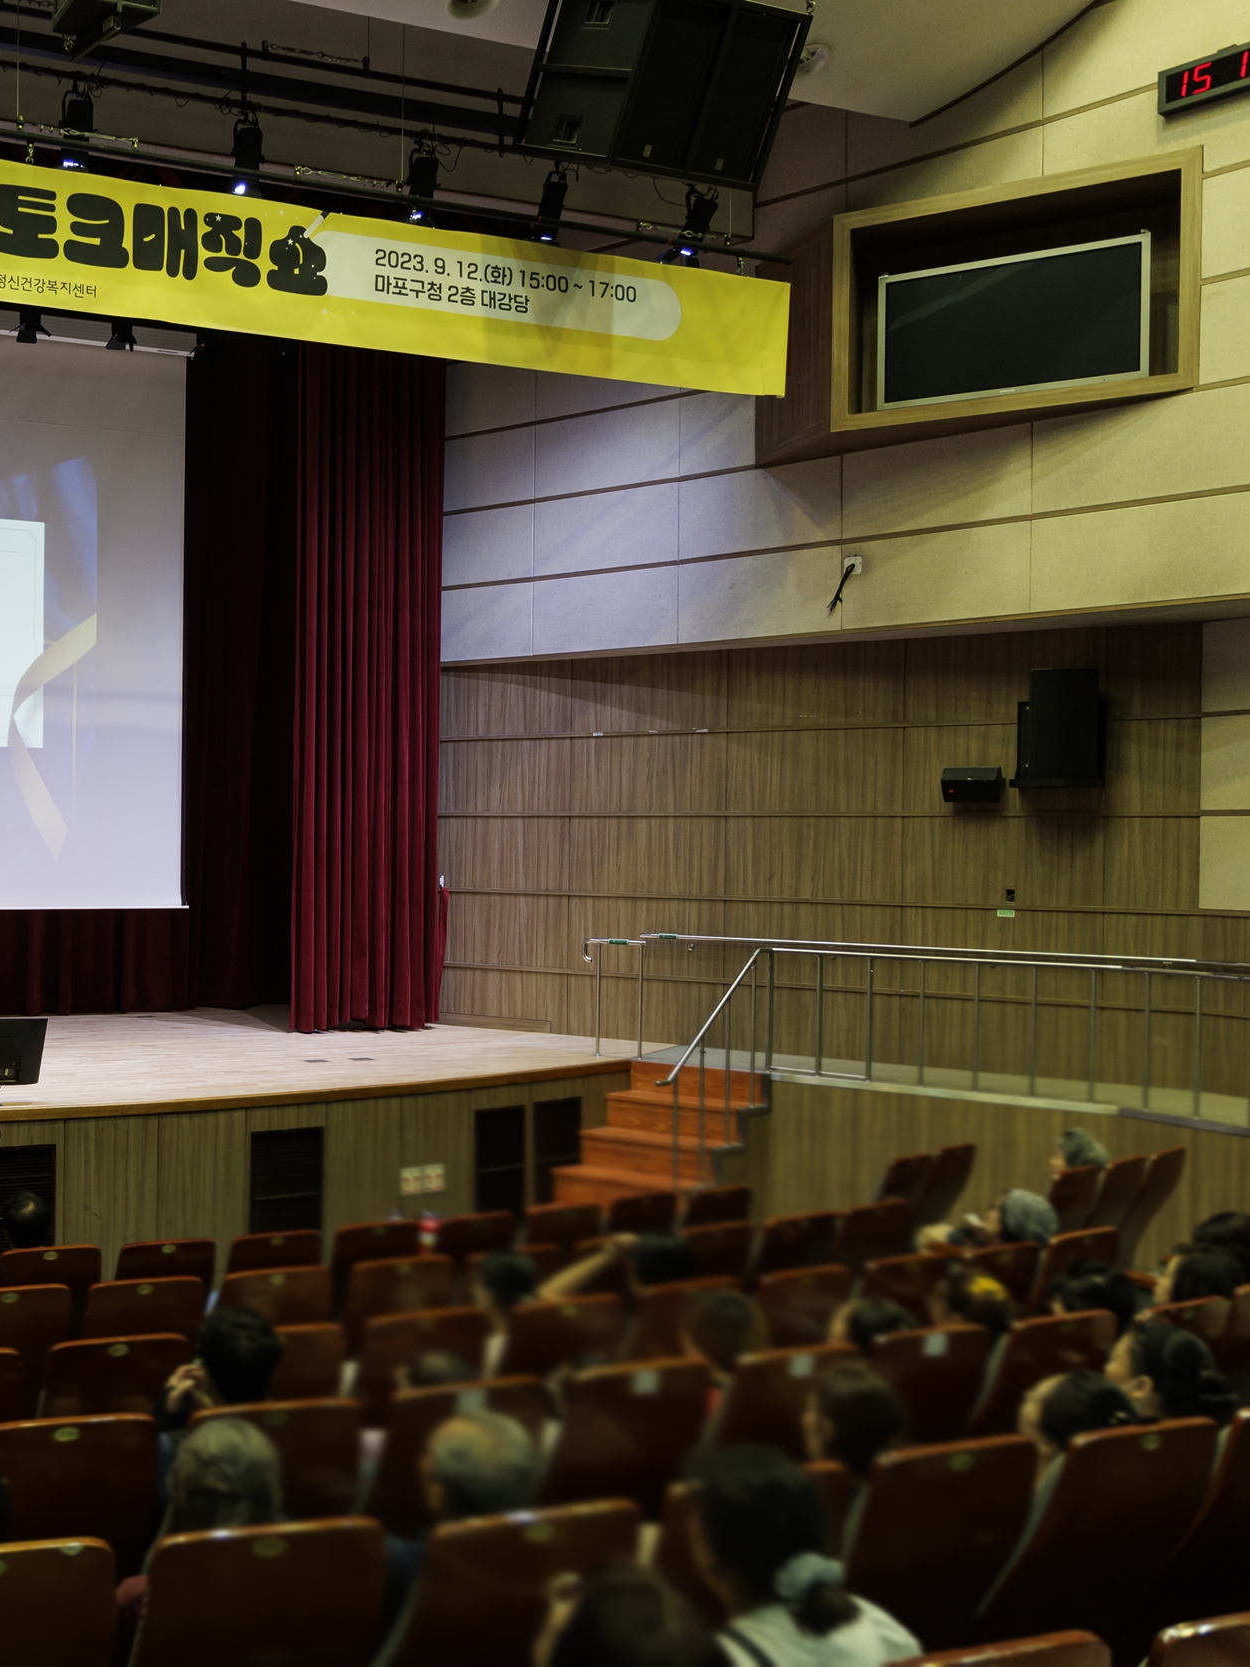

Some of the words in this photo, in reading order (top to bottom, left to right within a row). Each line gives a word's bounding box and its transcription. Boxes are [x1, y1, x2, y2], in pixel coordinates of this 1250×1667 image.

[1180, 61, 1212, 97] 15
[374, 275, 443, 303] 마포구청
[447, 286, 477, 307] 2층
[480, 289, 531, 314] 대강당
[518, 269, 570, 294] 15:00
[588, 279, 637, 303] 17:00
